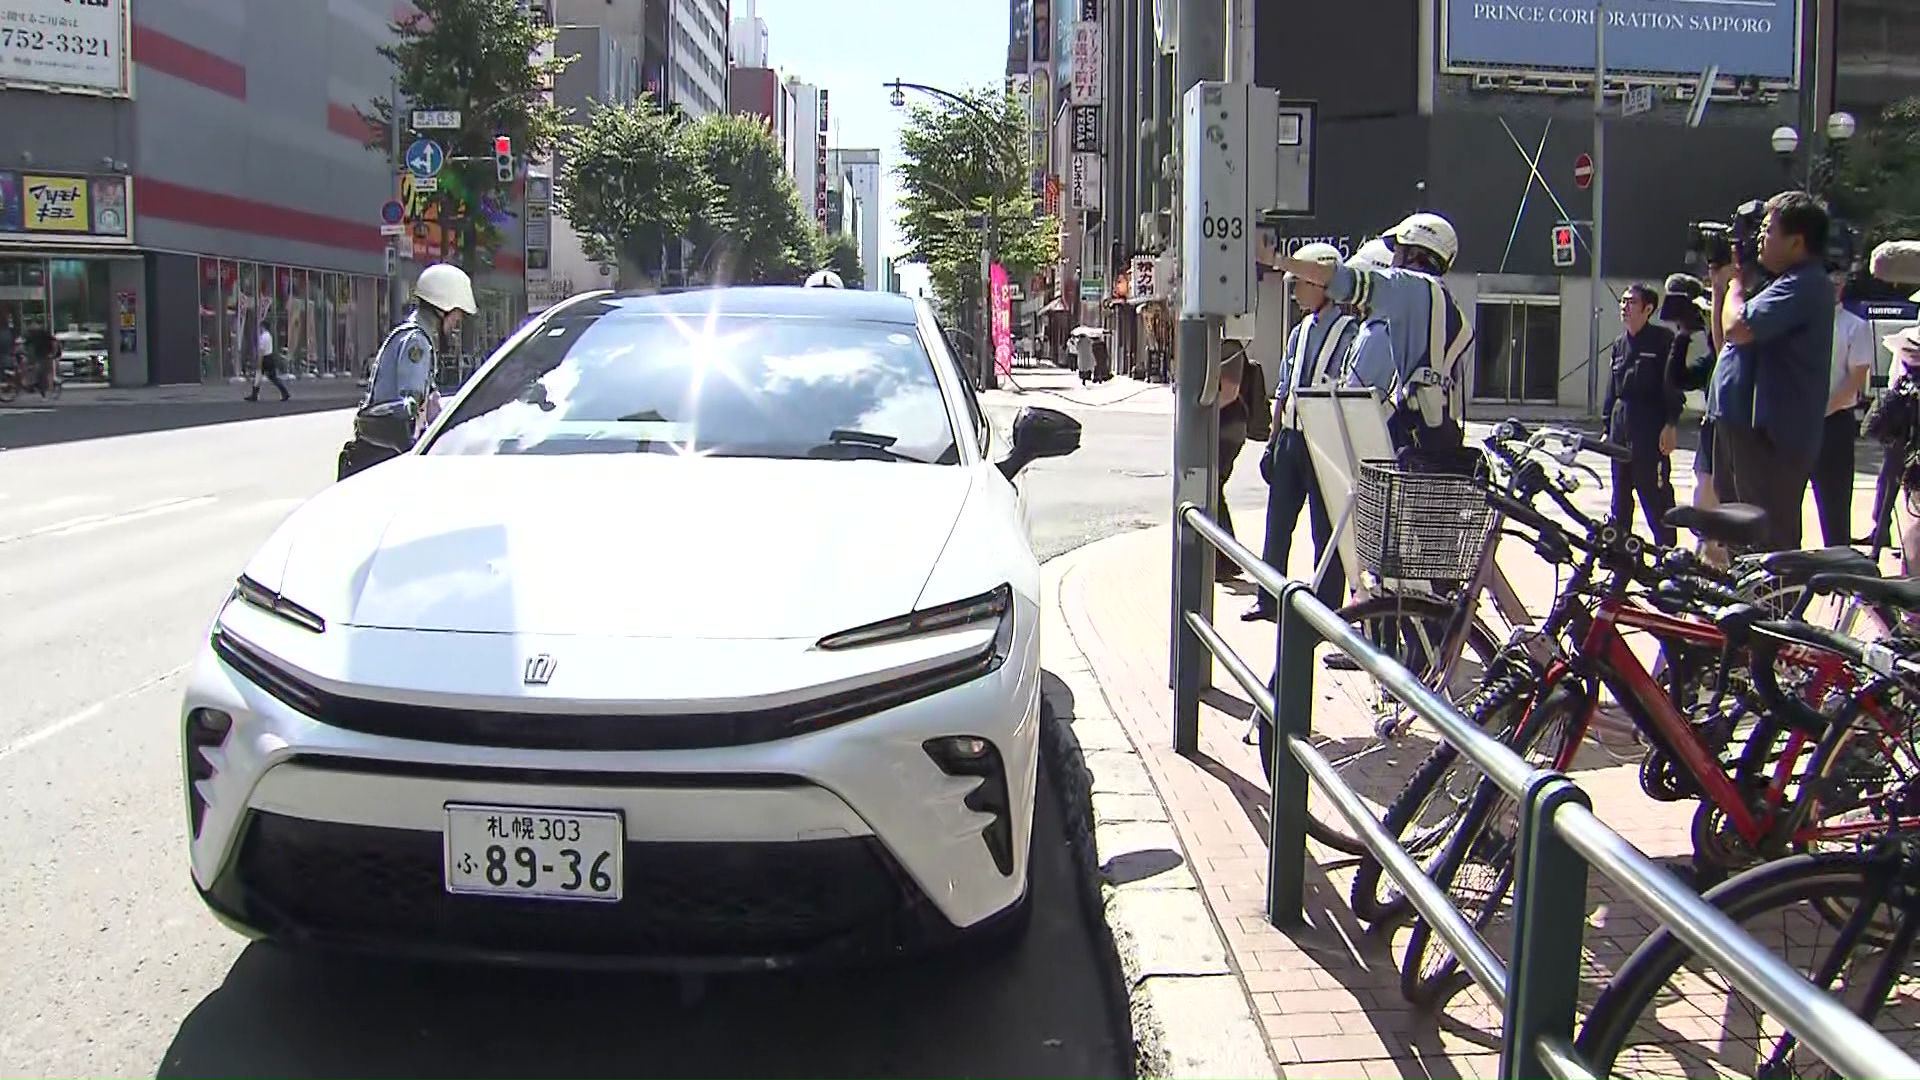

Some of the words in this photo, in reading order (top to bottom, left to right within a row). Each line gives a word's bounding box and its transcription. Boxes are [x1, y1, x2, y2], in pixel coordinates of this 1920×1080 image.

[1474, 3, 1545, 22] PRINCE
[1549, 7, 1684, 29] CORORATION
[1689, 14, 1772, 33] SAPPORO
[2, 28, 109, 57] 752-3321
[1076, 107, 1086, 150] VEGAS
[1086, 107, 1096, 141] LOVE
[29, 185, 81, 204] マツモト
[36, 203, 76, 222] キヨシ
[1202, 216, 1243, 239] 093
[487, 816, 534, 840] 札幌
[539, 818, 581, 842] 303
[457, 852, 479, 875] ふ
[486, 844, 612, 893] 89-36
